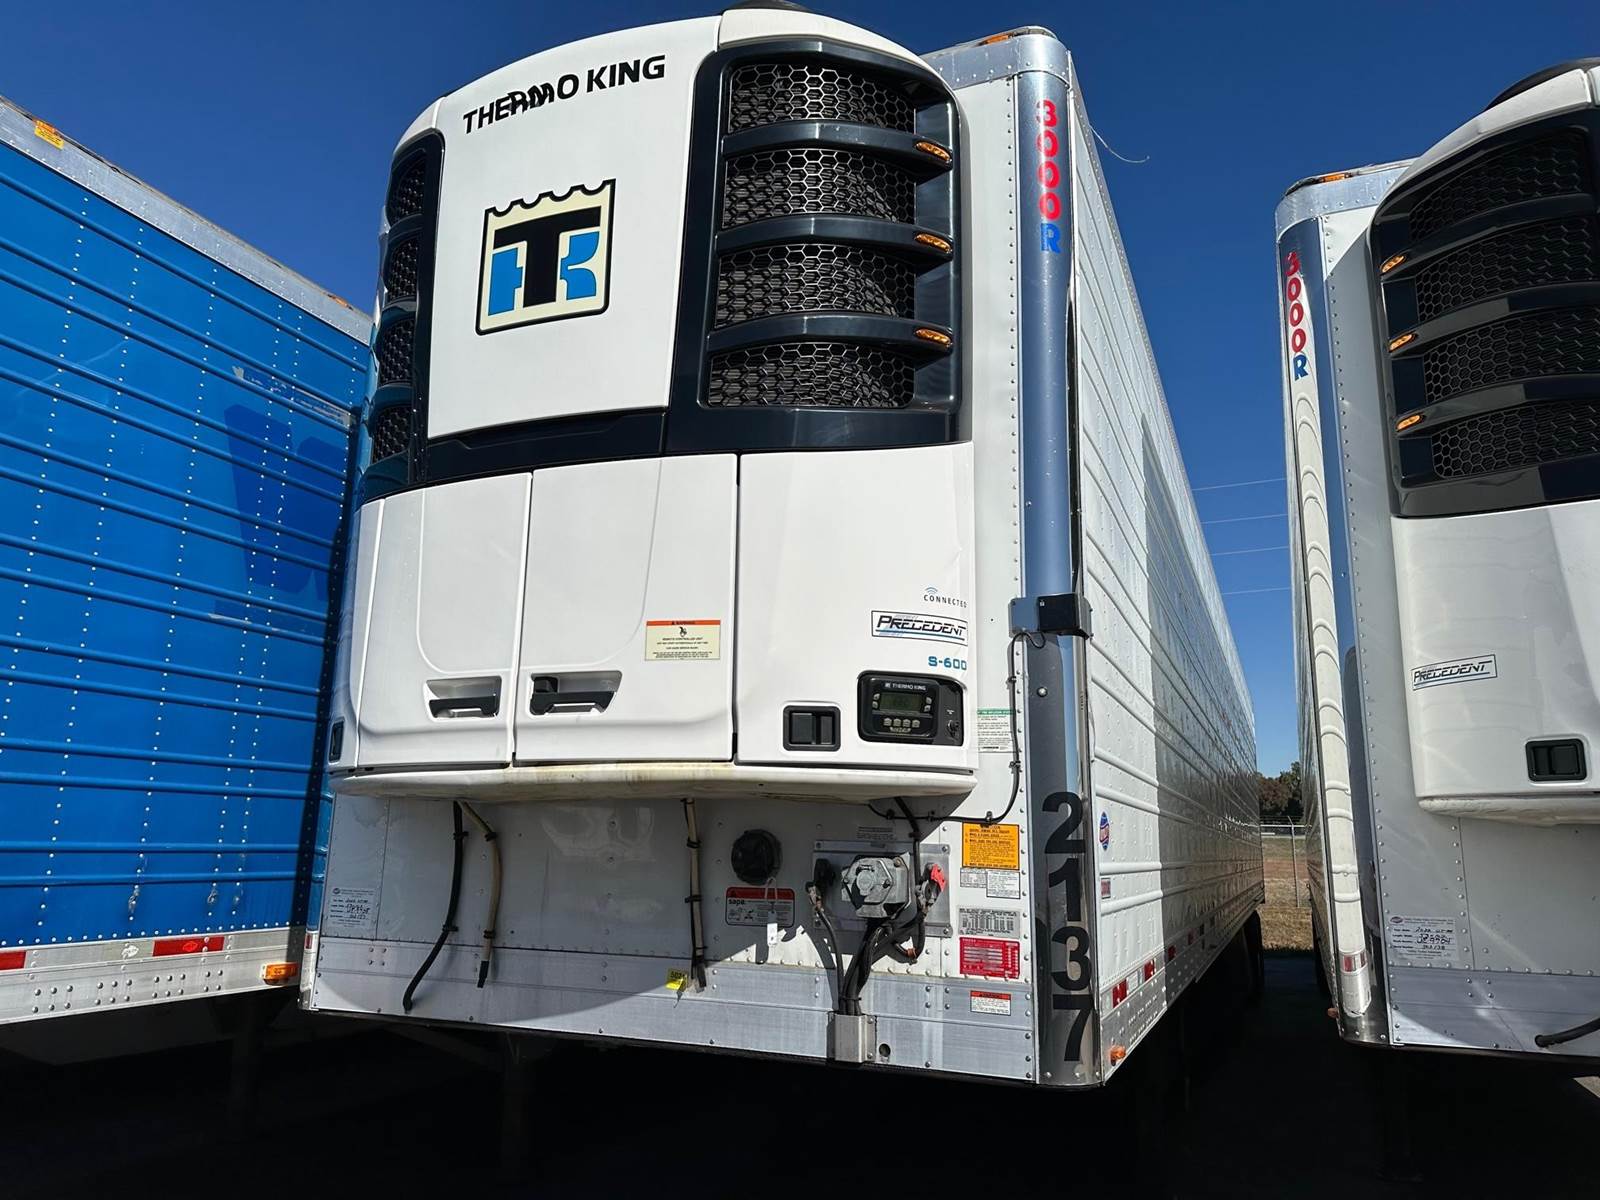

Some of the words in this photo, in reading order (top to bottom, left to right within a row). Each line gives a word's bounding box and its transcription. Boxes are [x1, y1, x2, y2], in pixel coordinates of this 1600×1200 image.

[463, 73, 580, 134] THERMO
[586, 54, 666, 93] KING
[1035, 98, 1062, 254] 3000R
[1284, 251, 1309, 382] 3000R
[876, 614, 967, 637] PRECEDENT
[923, 594, 967, 608] CONNECTED
[927, 655, 967, 671] S-600
[1413, 660, 1493, 682] PRECEDENT
[1042, 791, 1094, 1062] 2137
